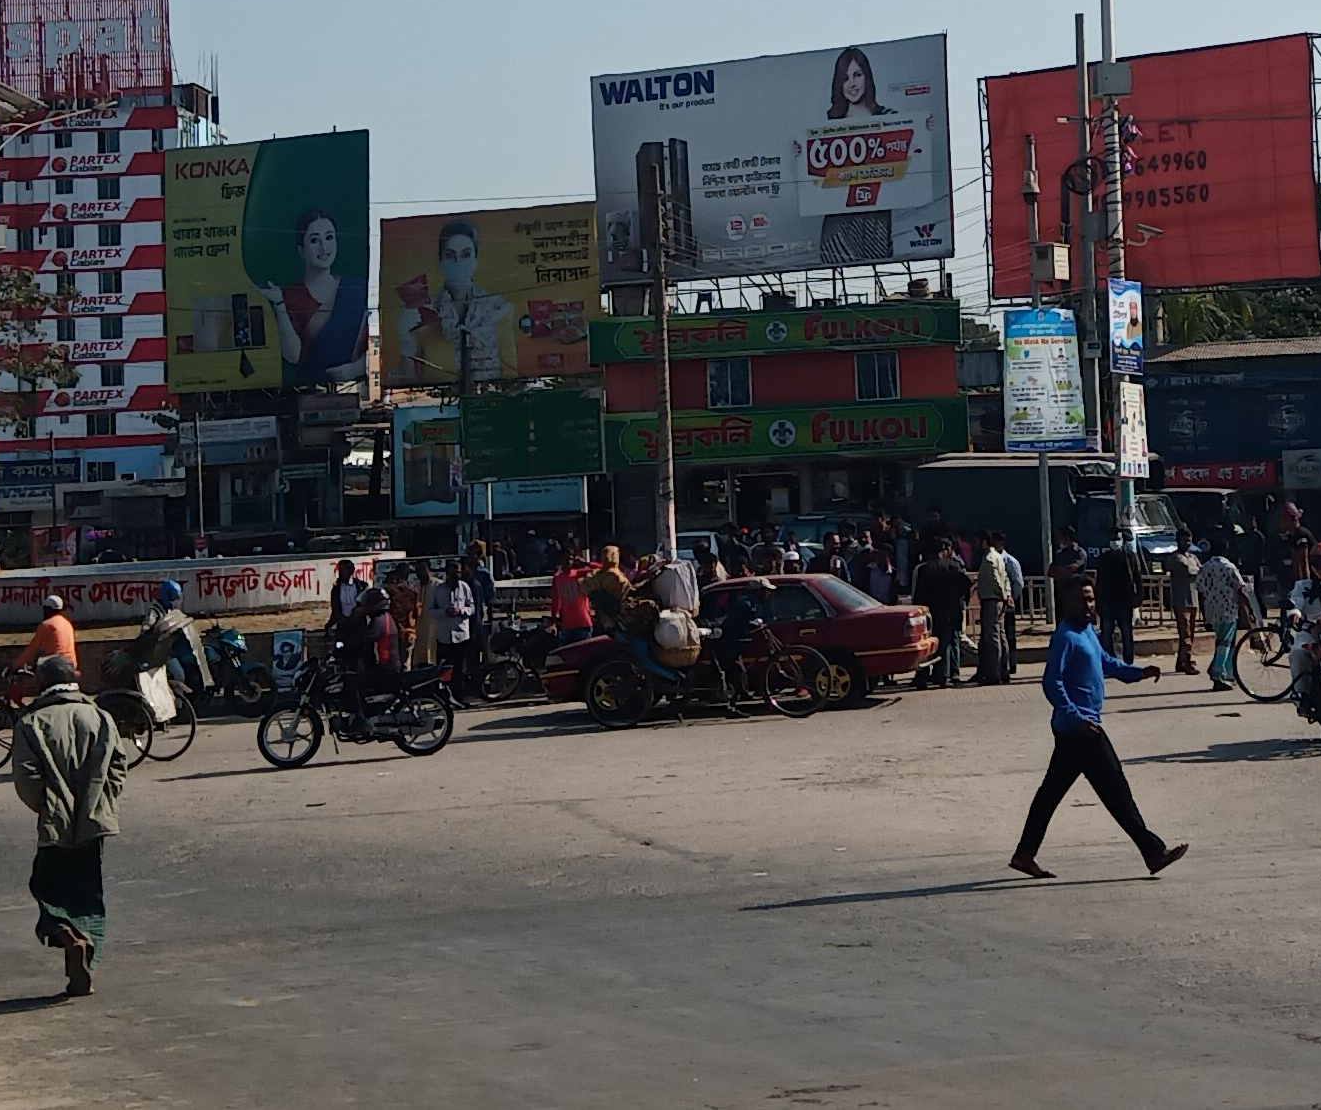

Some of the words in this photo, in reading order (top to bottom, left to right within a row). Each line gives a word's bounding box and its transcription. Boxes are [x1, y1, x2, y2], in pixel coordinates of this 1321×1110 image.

[599, 70, 715, 105] WALTON
[672, 100, 684, 109] our
[686, 97, 715, 109] product
[69, 108, 118, 120] PARTEX
[810, 136, 884, 168] ৫০০%
[71, 155, 121, 165] PARTEX
[175, 158, 249, 180] KONKA
[71, 202, 121, 212] PARTEX
[72, 248, 122, 259] PARTEX
[536, 265, 590, 283] নিরাপদ
[72, 295, 122, 306] PARTEX
[804, 314, 920, 340] FULKOLI
[73, 341, 123, 352] PARTEX
[73, 390, 124, 400] PARTEX
[812, 412, 927, 443] FULKOLI
